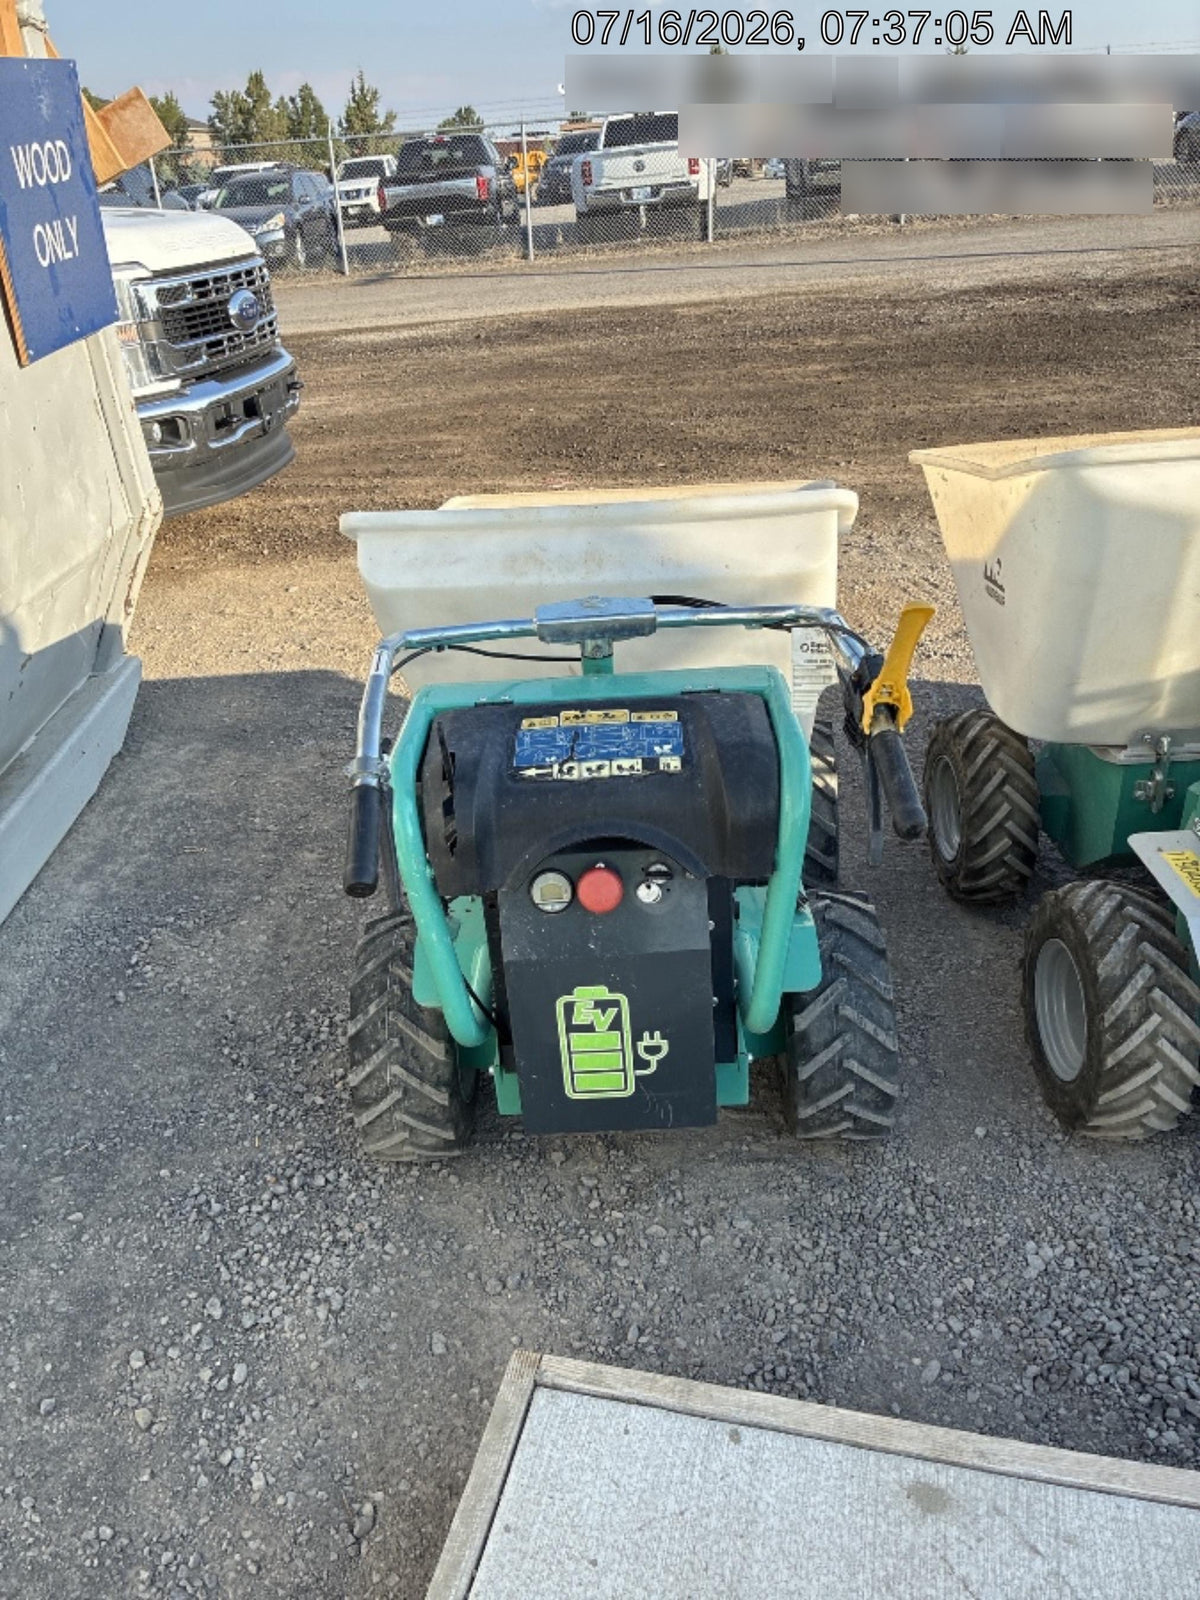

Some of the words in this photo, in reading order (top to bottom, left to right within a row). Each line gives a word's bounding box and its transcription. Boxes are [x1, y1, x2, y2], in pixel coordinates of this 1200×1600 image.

[10, 140, 71, 189] WOOD
[33, 215, 79, 267] ONLY
[572, 1000, 619, 1032] EV
